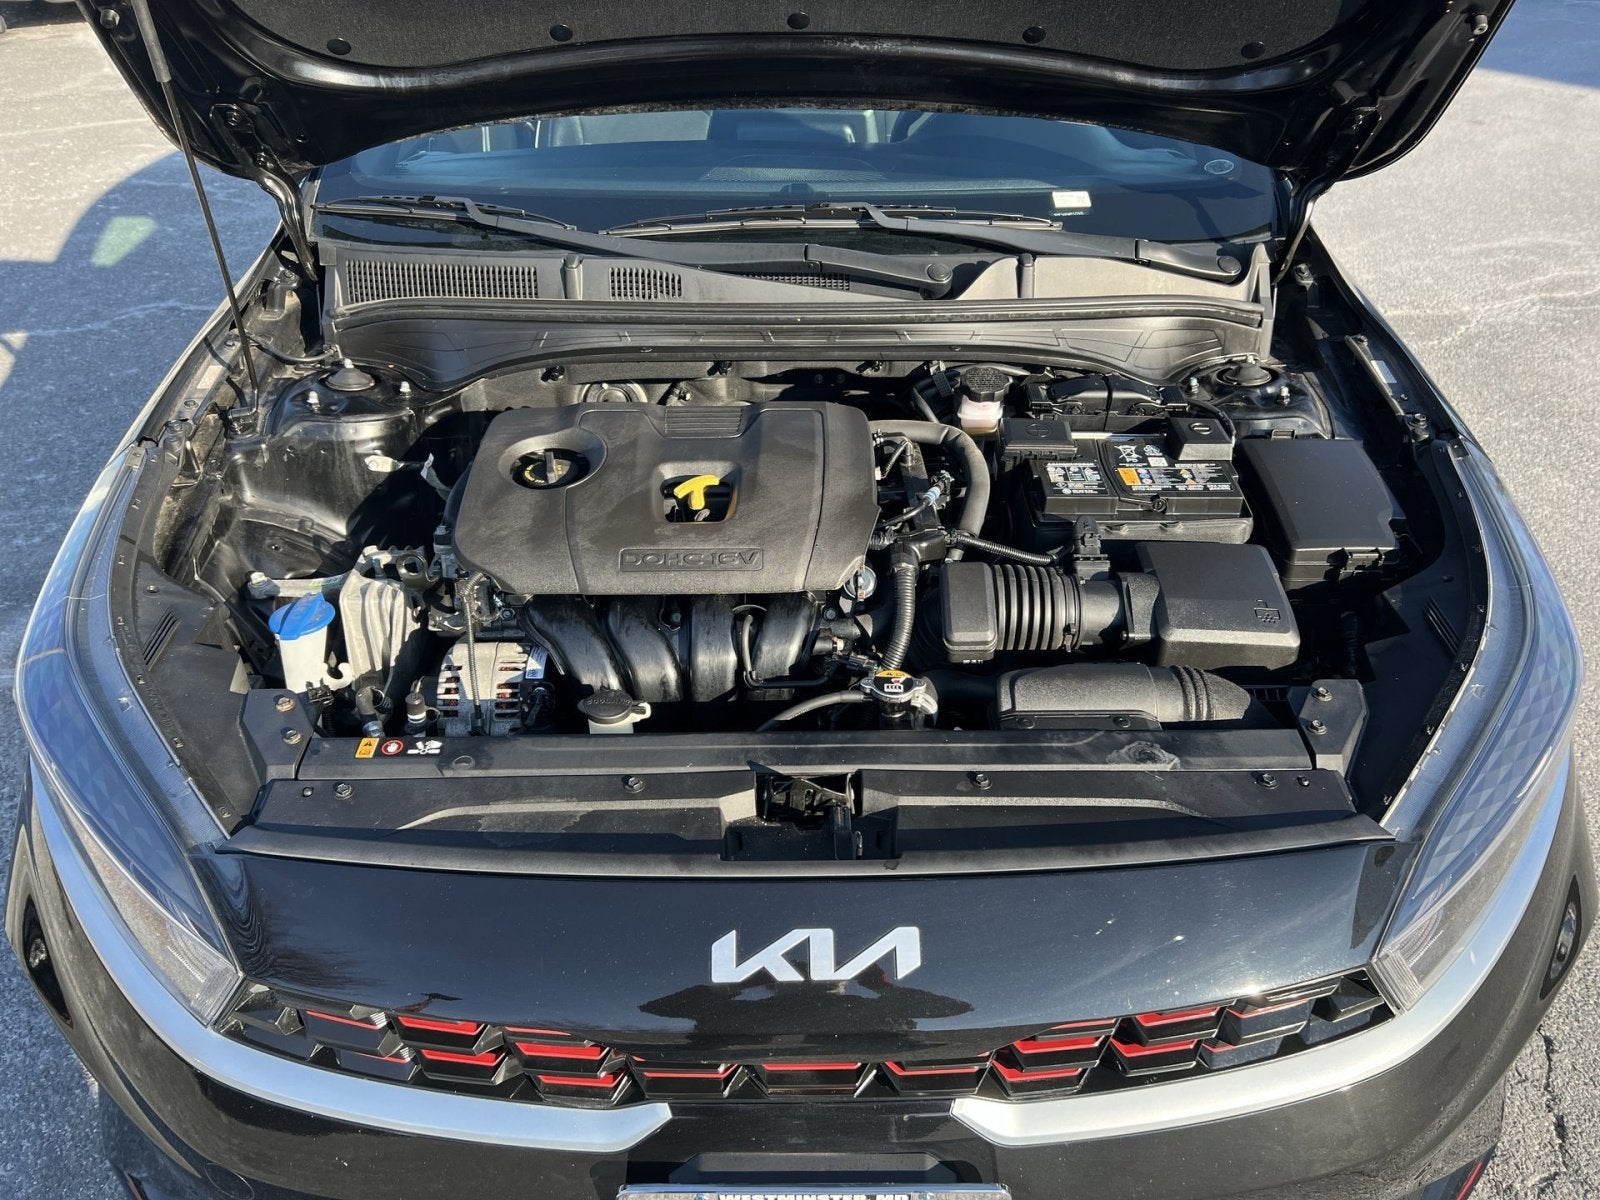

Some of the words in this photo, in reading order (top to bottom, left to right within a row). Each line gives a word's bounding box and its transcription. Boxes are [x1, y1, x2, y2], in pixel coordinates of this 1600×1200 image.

[621, 552, 705, 566] DOHC
[710, 552, 760, 566] 16V
[712, 927, 921, 983] KIA
